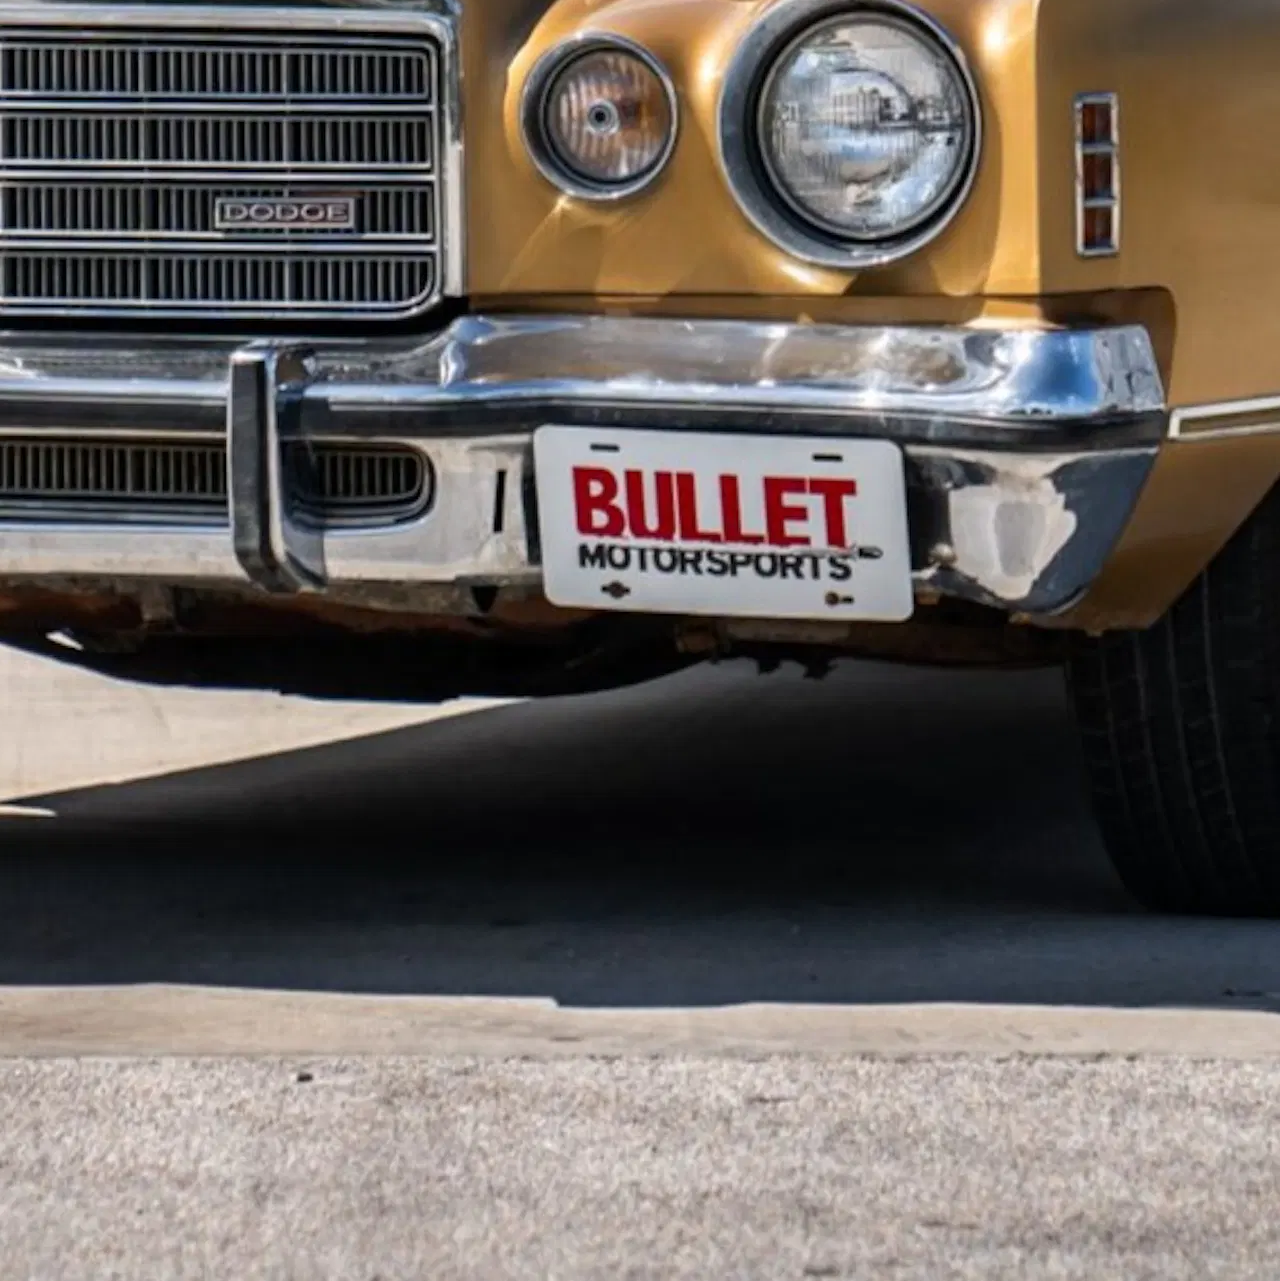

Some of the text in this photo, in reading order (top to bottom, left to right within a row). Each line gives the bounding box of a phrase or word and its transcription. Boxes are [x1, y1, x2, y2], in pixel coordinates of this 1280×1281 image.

[224, 203, 349, 221] DODGE
[572, 466, 858, 548] BULLET
[578, 543, 853, 581] MOTORSPORTS
